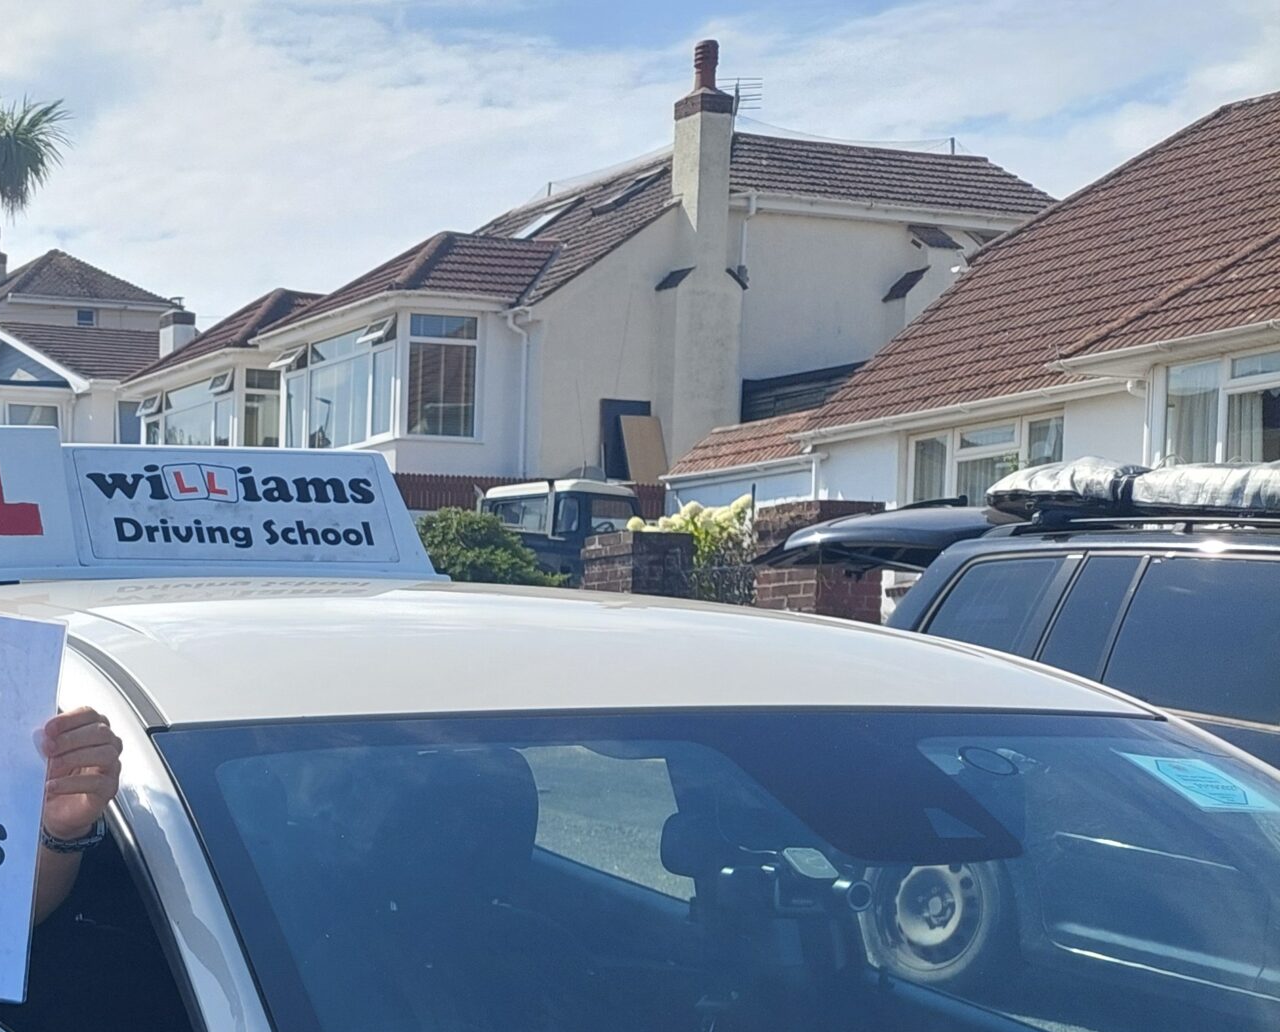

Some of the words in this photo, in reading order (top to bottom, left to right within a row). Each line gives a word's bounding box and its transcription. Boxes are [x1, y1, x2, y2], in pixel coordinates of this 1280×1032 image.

[86, 464, 375, 504] wiLLiams
[114, 517, 253, 548] Driving
[262, 519, 374, 546] School
